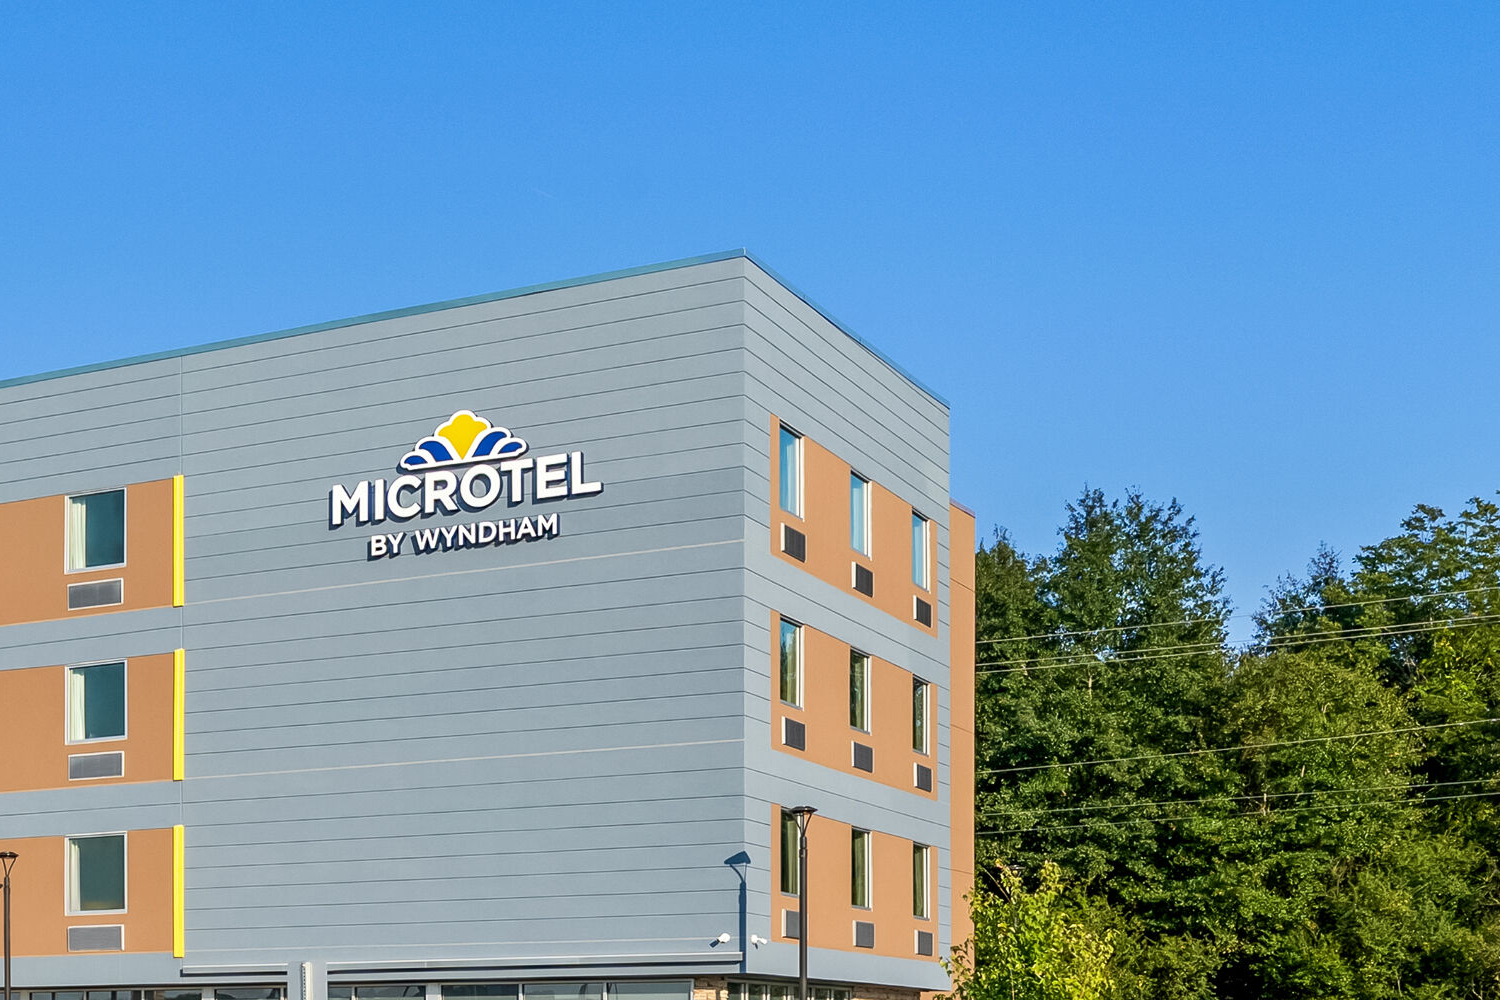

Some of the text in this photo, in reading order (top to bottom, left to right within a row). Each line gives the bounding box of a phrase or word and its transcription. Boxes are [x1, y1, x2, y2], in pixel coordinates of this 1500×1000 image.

[331, 451, 602, 525] MICROTEL
[370, 513, 559, 557] BY WYNDHAM
